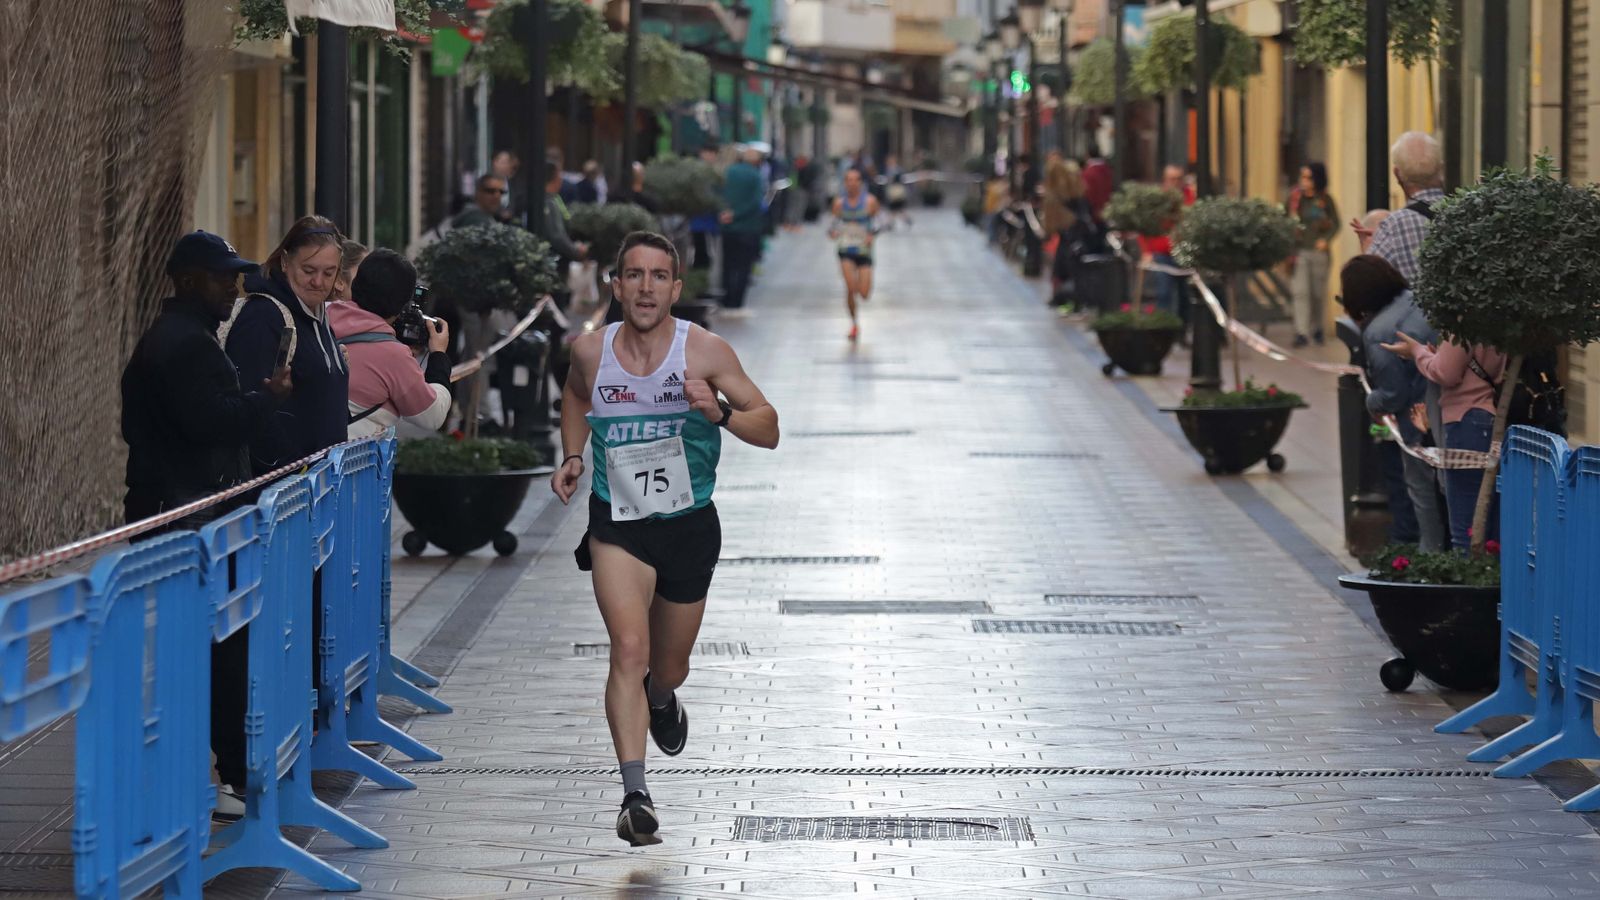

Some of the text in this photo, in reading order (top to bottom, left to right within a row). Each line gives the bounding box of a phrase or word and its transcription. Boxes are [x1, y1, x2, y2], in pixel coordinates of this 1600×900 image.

[604, 388, 636, 401] ZENIT
[605, 419, 686, 442] ATLEET
[635, 468, 670, 496] 75
